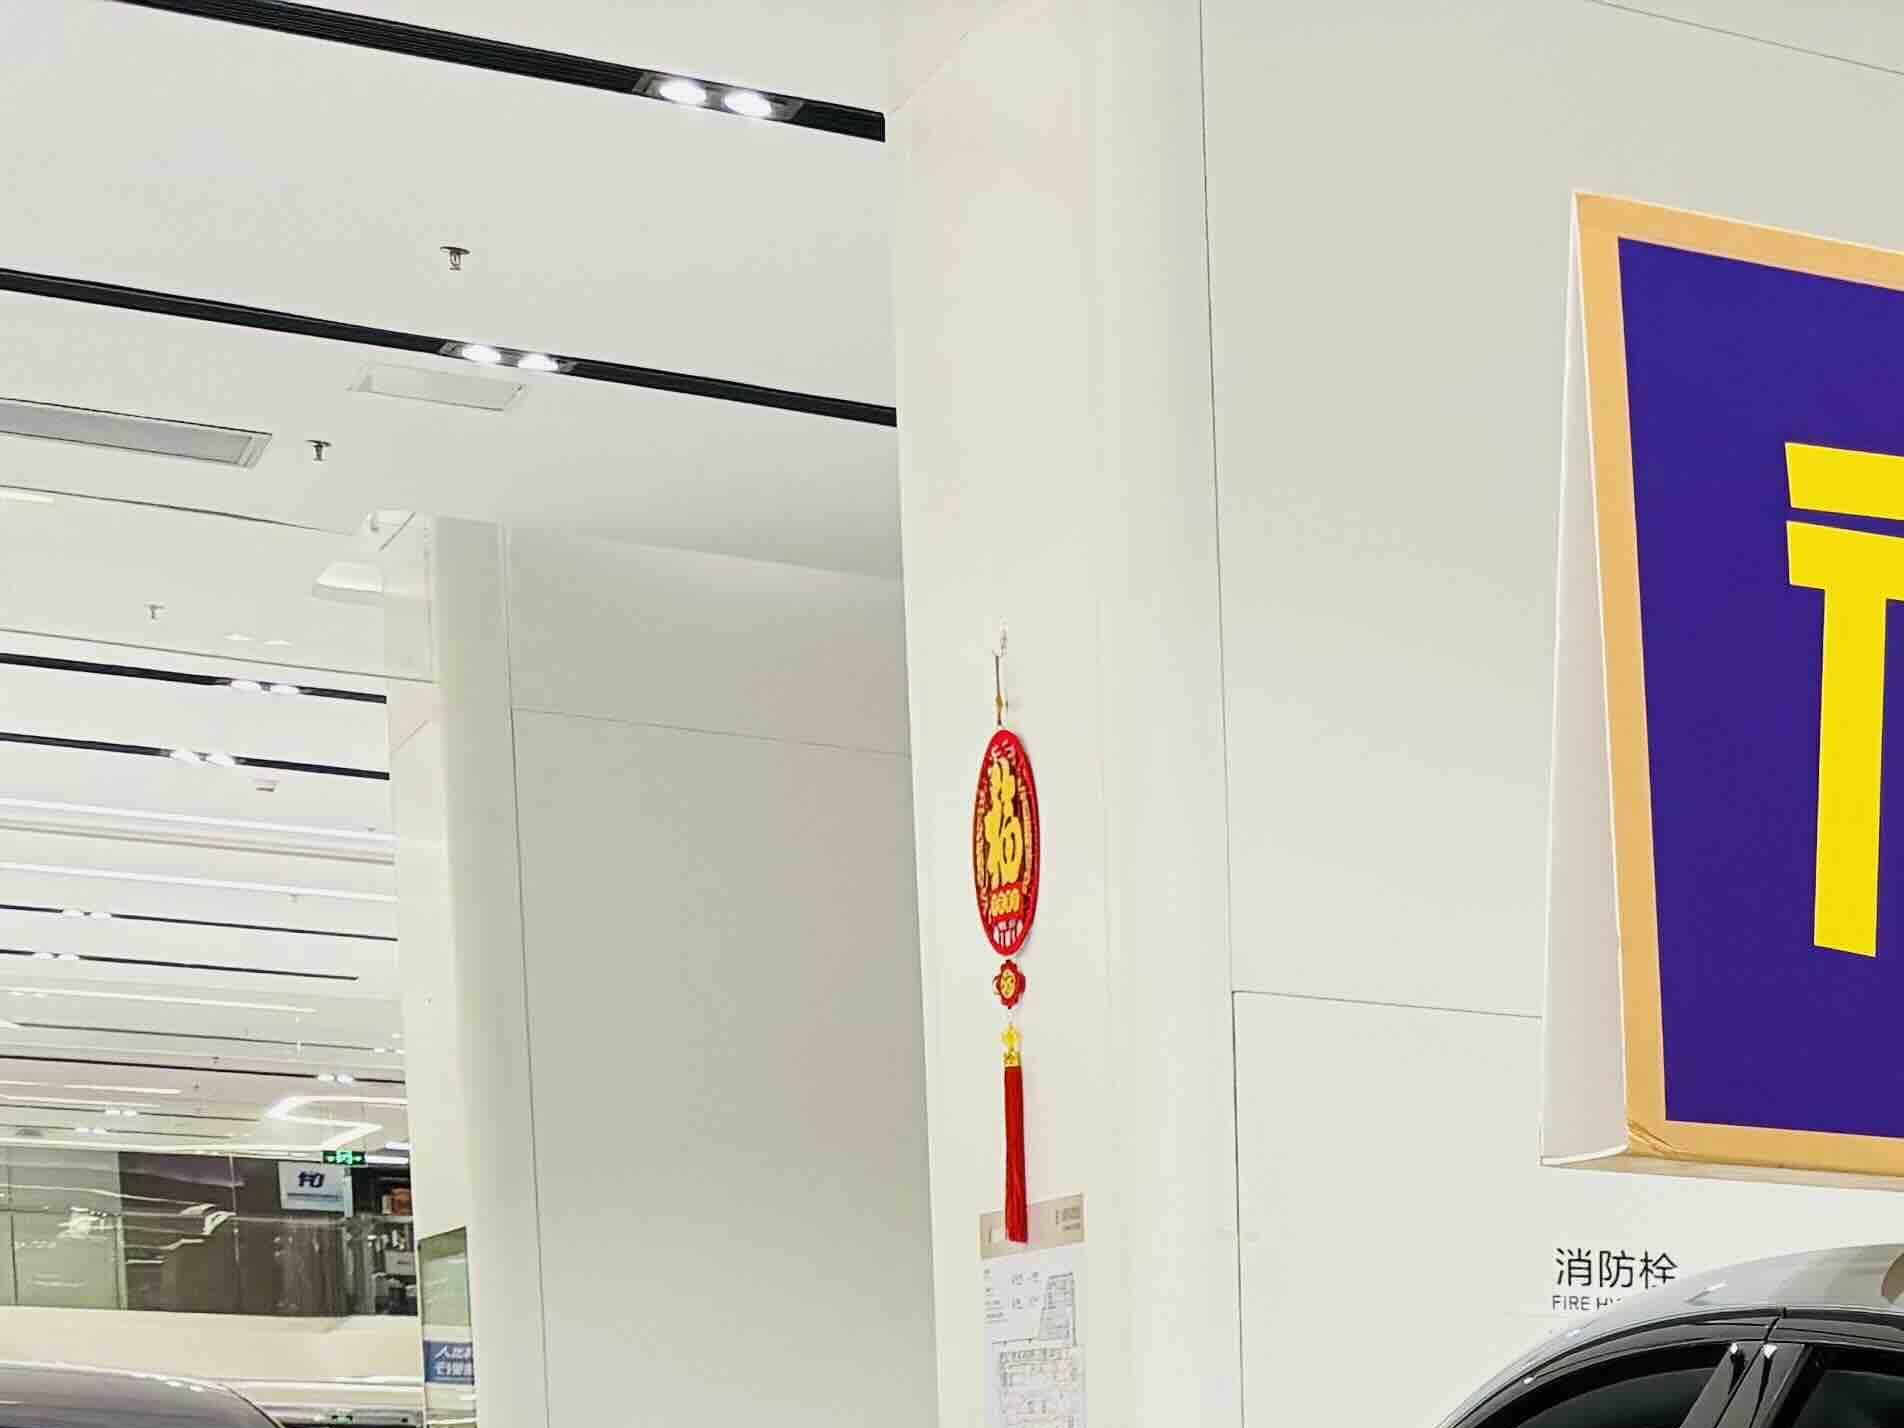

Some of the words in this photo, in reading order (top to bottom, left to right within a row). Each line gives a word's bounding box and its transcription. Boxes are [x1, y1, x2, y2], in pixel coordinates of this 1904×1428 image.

[1556, 1248, 1678, 1289] 消防栓
[1552, 1295, 1592, 1311] FIRE
